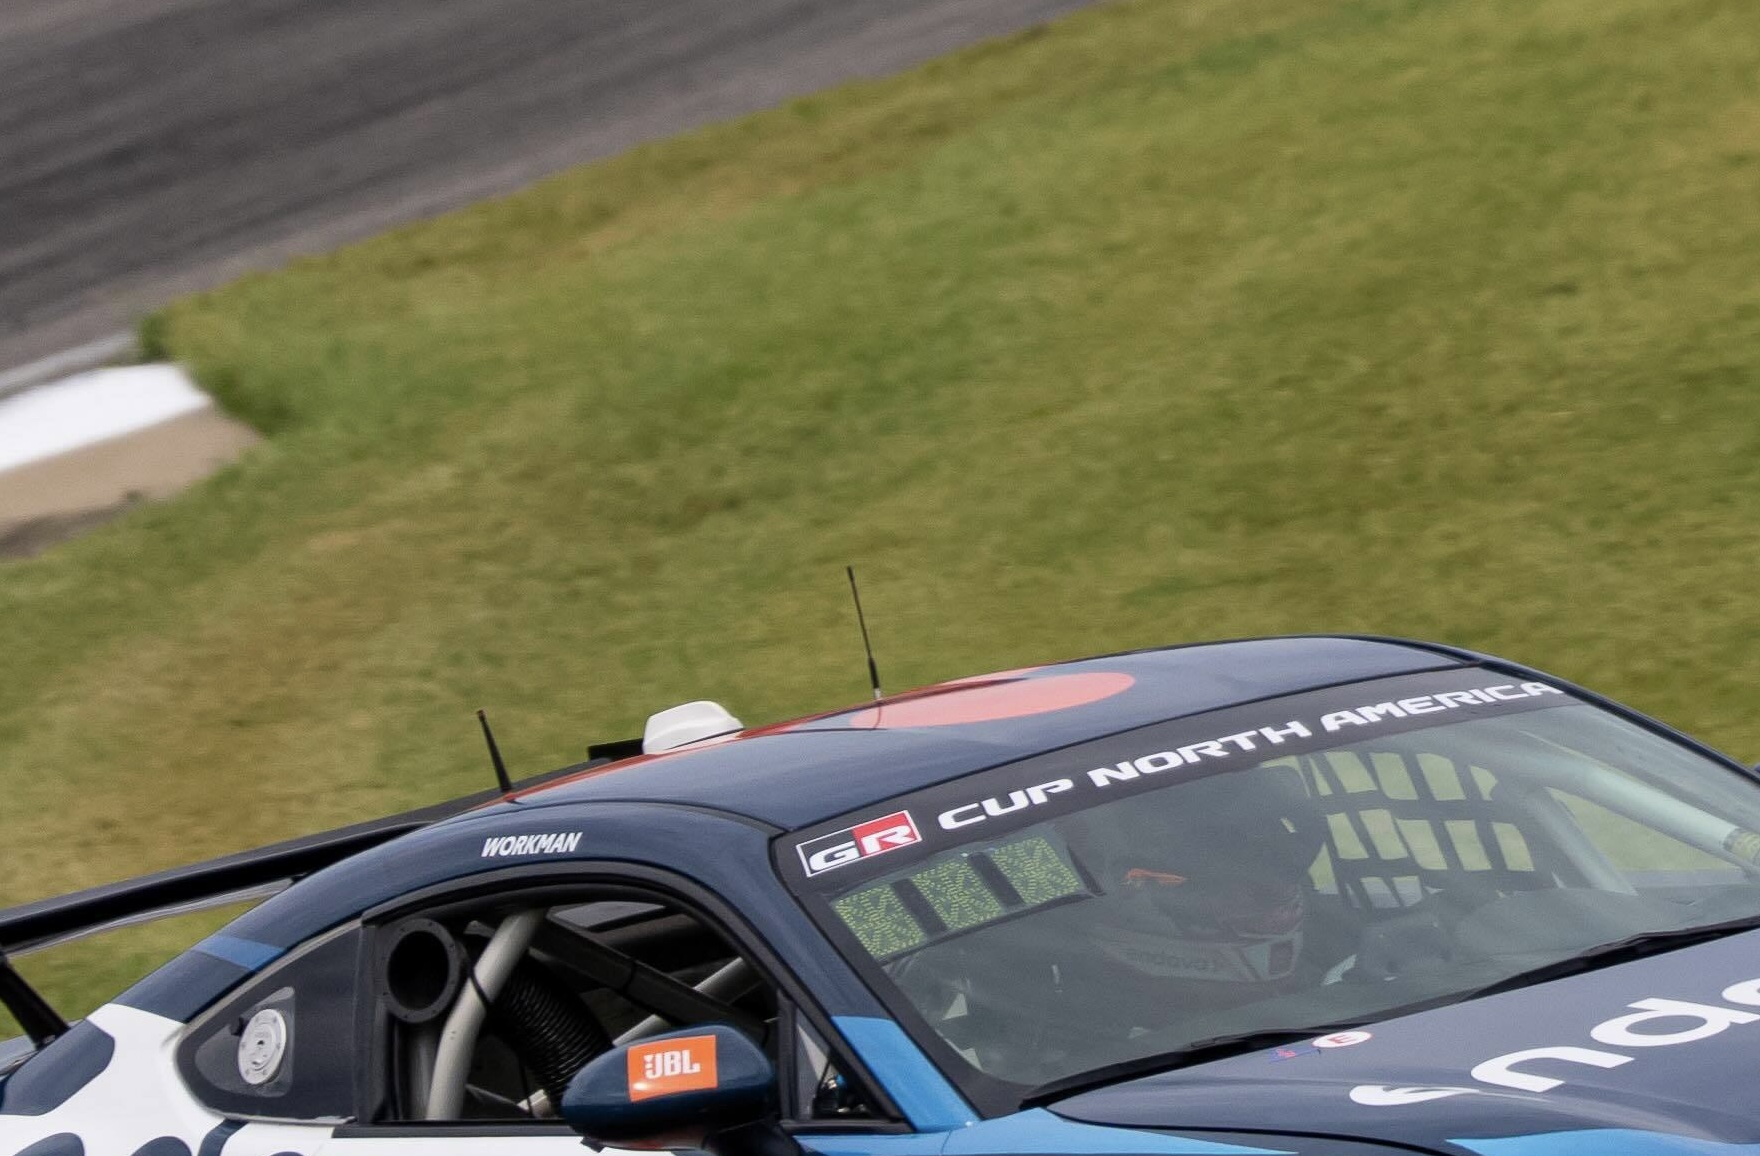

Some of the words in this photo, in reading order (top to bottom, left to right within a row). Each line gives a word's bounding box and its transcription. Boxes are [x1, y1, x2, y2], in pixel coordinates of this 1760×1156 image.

[807, 824, 916, 872] GR
[937, 778, 1075, 830] CUP
[1087, 720, 1313, 788] NORTH
[1320, 681, 1566, 732] AMERICA
[480, 831, 584, 858] WORKMAN
[643, 1049, 701, 1080] JBL
